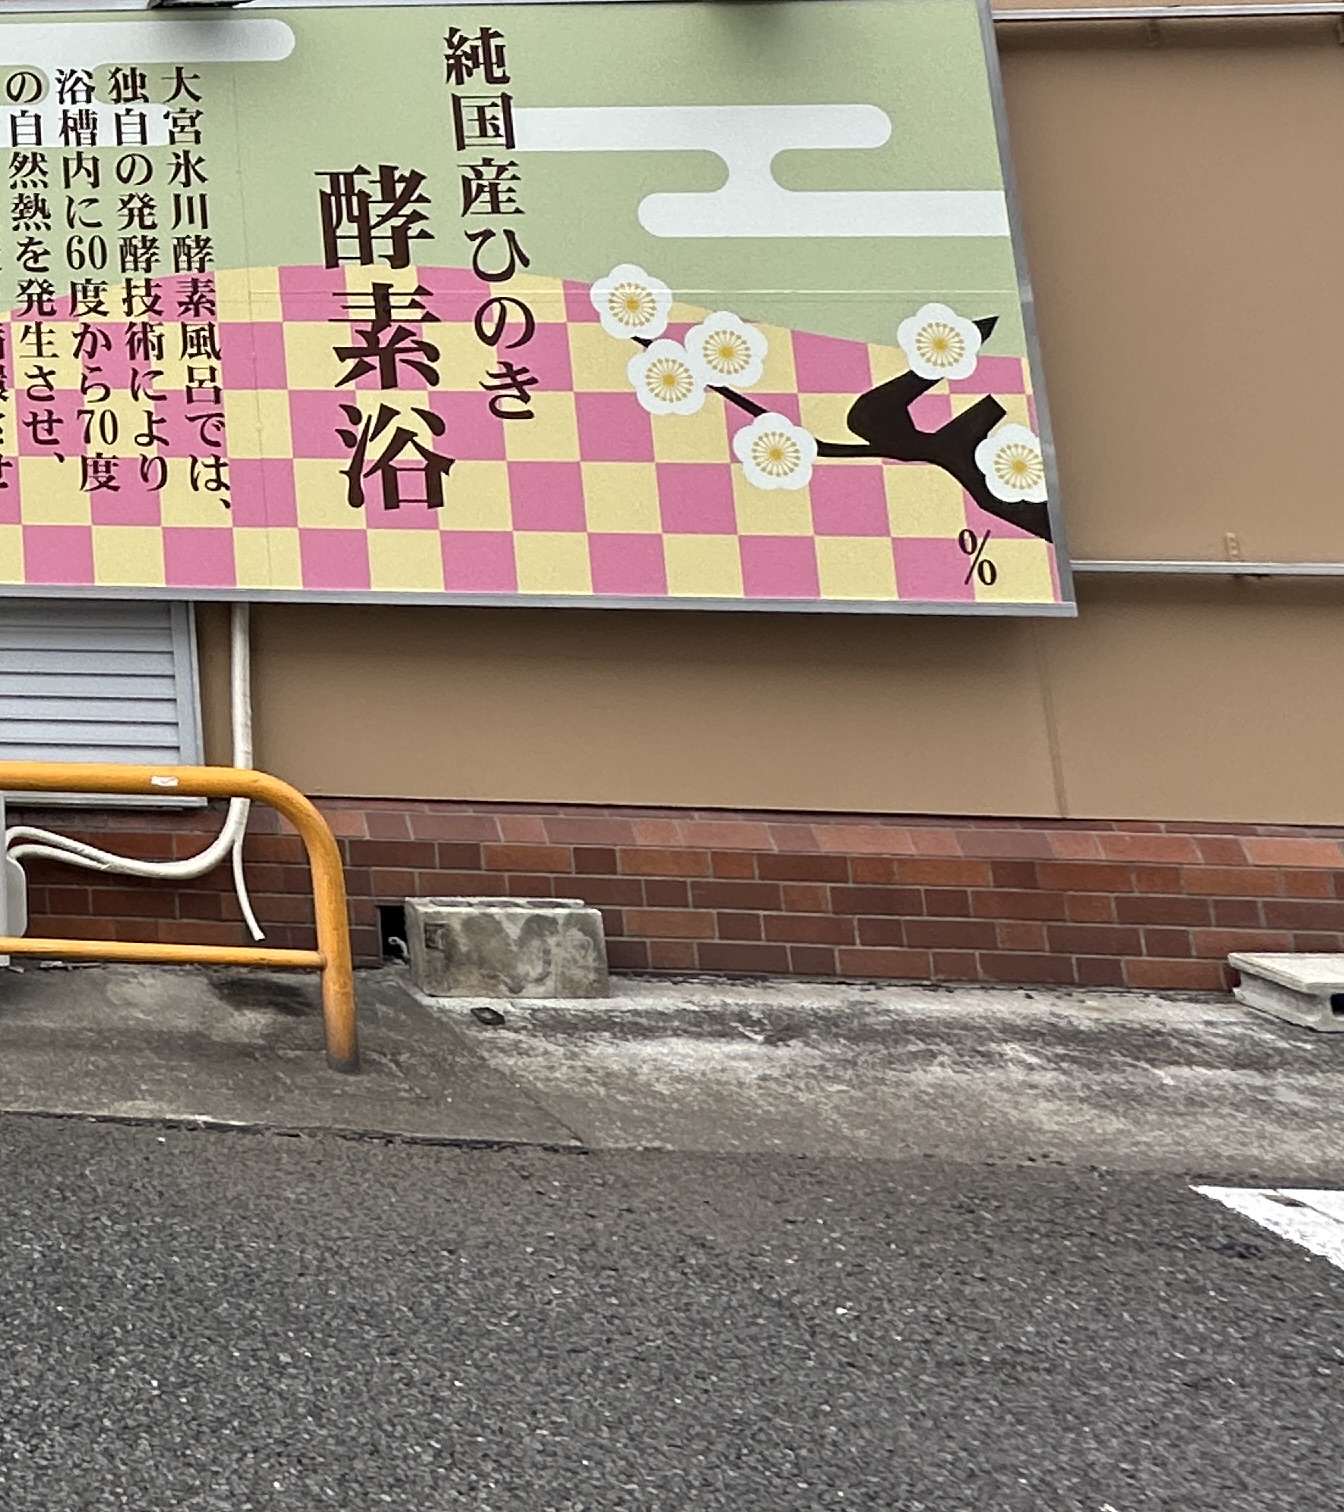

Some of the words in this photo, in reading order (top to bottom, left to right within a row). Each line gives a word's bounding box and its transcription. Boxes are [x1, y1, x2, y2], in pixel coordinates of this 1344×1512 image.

[5, 70, 67, 464] の自然熱を発生させ、
[55, 68, 121, 492] 浴槽内に60度から70度
[108, 67, 169, 492] 独自の発酵技術により
[161, 66, 232, 510] 大宮氷川酵素風呂では、
[313, 164, 456, 511] 酵素浴
[442, 26, 539, 420] 純国産ひのき
[958, 528, 997, 586] %
